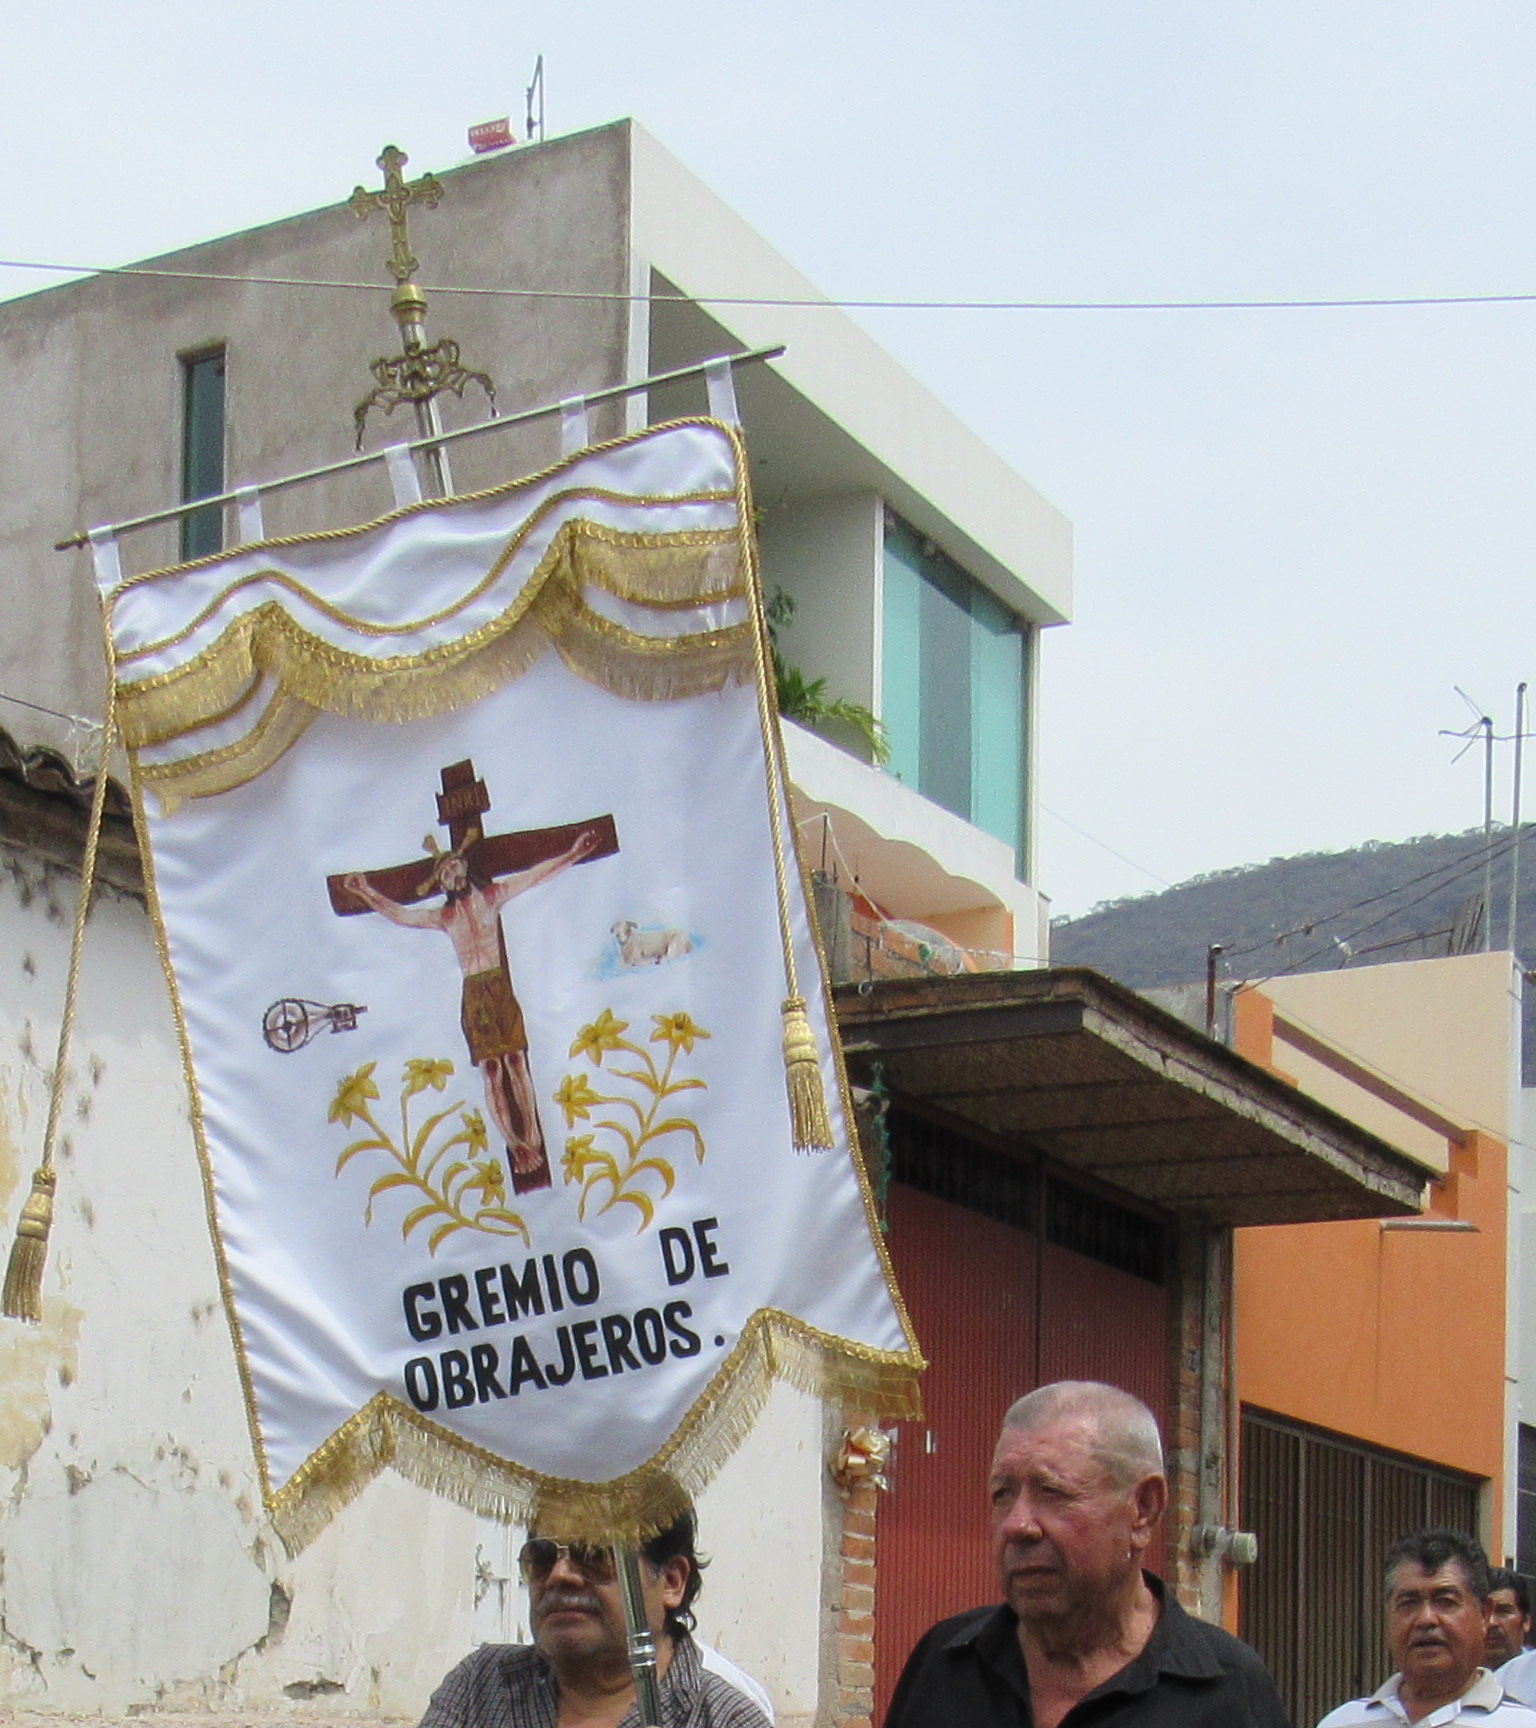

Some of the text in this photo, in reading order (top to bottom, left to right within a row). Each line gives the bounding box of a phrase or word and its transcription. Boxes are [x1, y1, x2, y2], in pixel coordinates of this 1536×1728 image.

[402, 1217, 729, 1342] GREMIO DE
[404, 1300, 725, 1413] OBRAJEROS.
